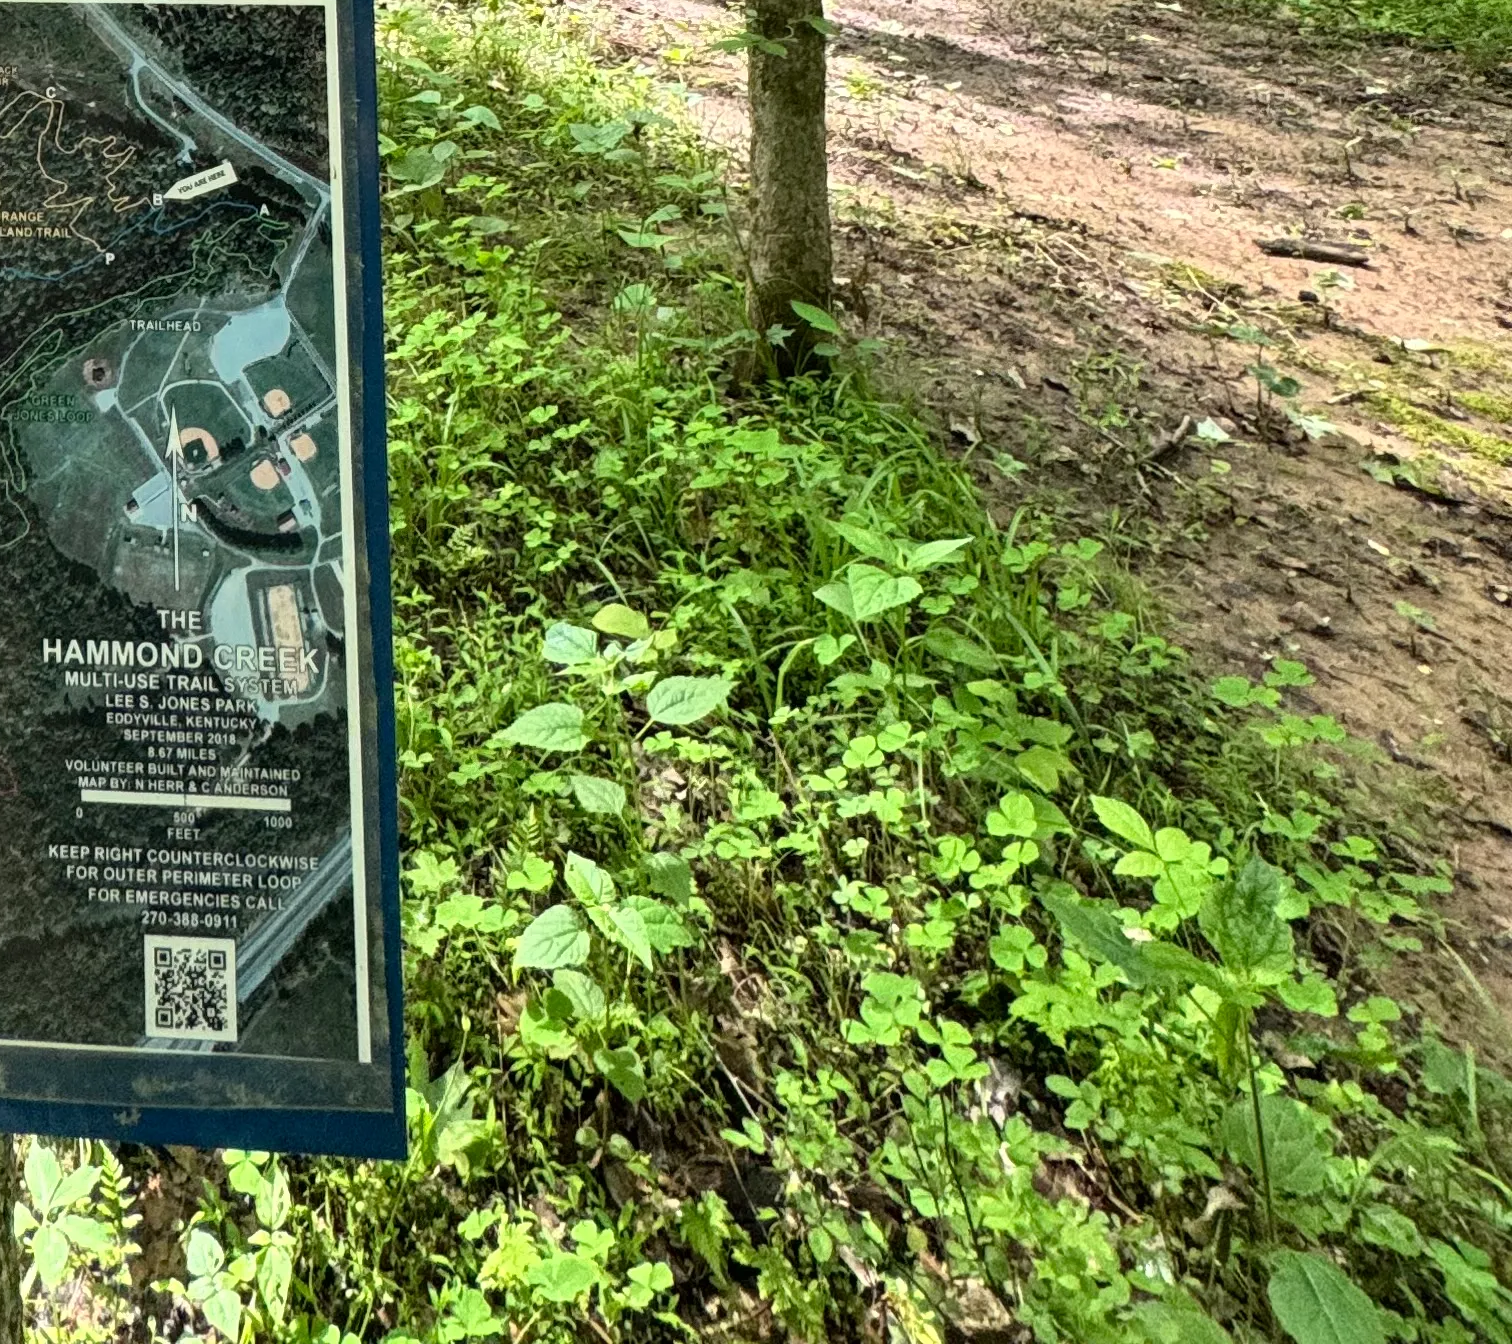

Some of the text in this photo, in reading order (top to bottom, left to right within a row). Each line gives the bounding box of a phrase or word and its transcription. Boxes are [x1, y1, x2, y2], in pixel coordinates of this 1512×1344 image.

[46, 86, 57, 98] C
[153, 193, 163, 205] B
[259, 203, 269, 216] A
[37, 228, 72, 238] TRAIL
[105, 252, 115, 265] P
[129, 319, 201, 331] TRAILHEAD
[31, 395, 75, 406] GREEN
[180, 503, 197, 522] N
[156, 610, 201, 629] THE
[43, 638, 320, 673] HAMMOND CREEK
[65, 671, 298, 694] MULTI-USE TRAIL SYSTEM
[105, 694, 257, 713] LEE S. JONES PARK
[106, 713, 256, 729] EDDYVILLE, KENTUCKY
[123, 730, 236, 745] SEPTEMBER 2018
[148, 747, 216, 760] 8.67 MILES
[65, 759, 300, 781] VOLUNTEER BUILT AND MAINTAINED
[78, 776, 288, 796] MAP BY: N HERR & C ANDERSON
[76, 807, 292, 828] 0 500 1000
[167, 828, 200, 840] FEET
[49, 844, 319, 870] KEEP RIGHT COUNTERCLOCKWISE
[67, 865, 302, 889] FOR OUTER PERIMETER LOOP
[88, 887, 285, 910] FOR EMERGENCIES CALL
[142, 910, 237, 928] 270-388-0911
